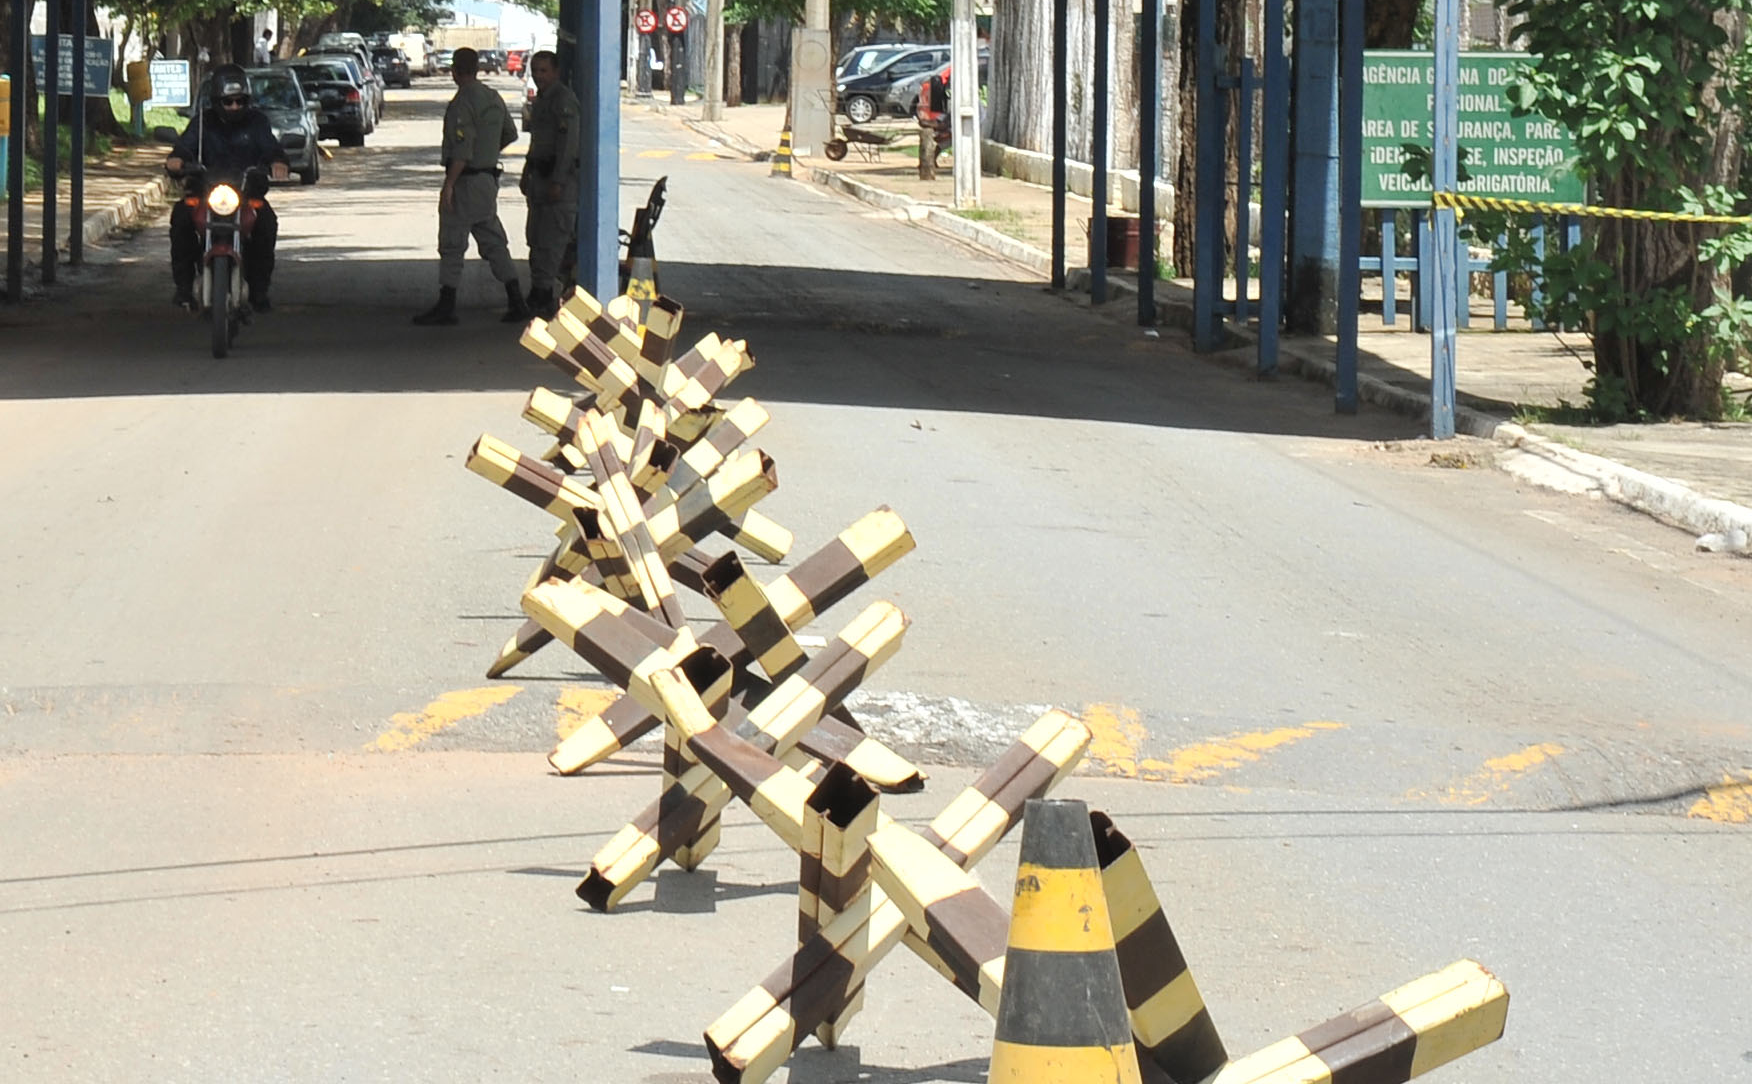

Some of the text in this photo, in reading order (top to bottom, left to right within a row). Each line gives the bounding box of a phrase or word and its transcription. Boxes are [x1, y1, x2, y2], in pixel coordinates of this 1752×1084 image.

[1401, 120, 1419, 138] DE
[1525, 122, 1562, 140] PARE
[1494, 145, 1563, 169] INSPEÇÃO
